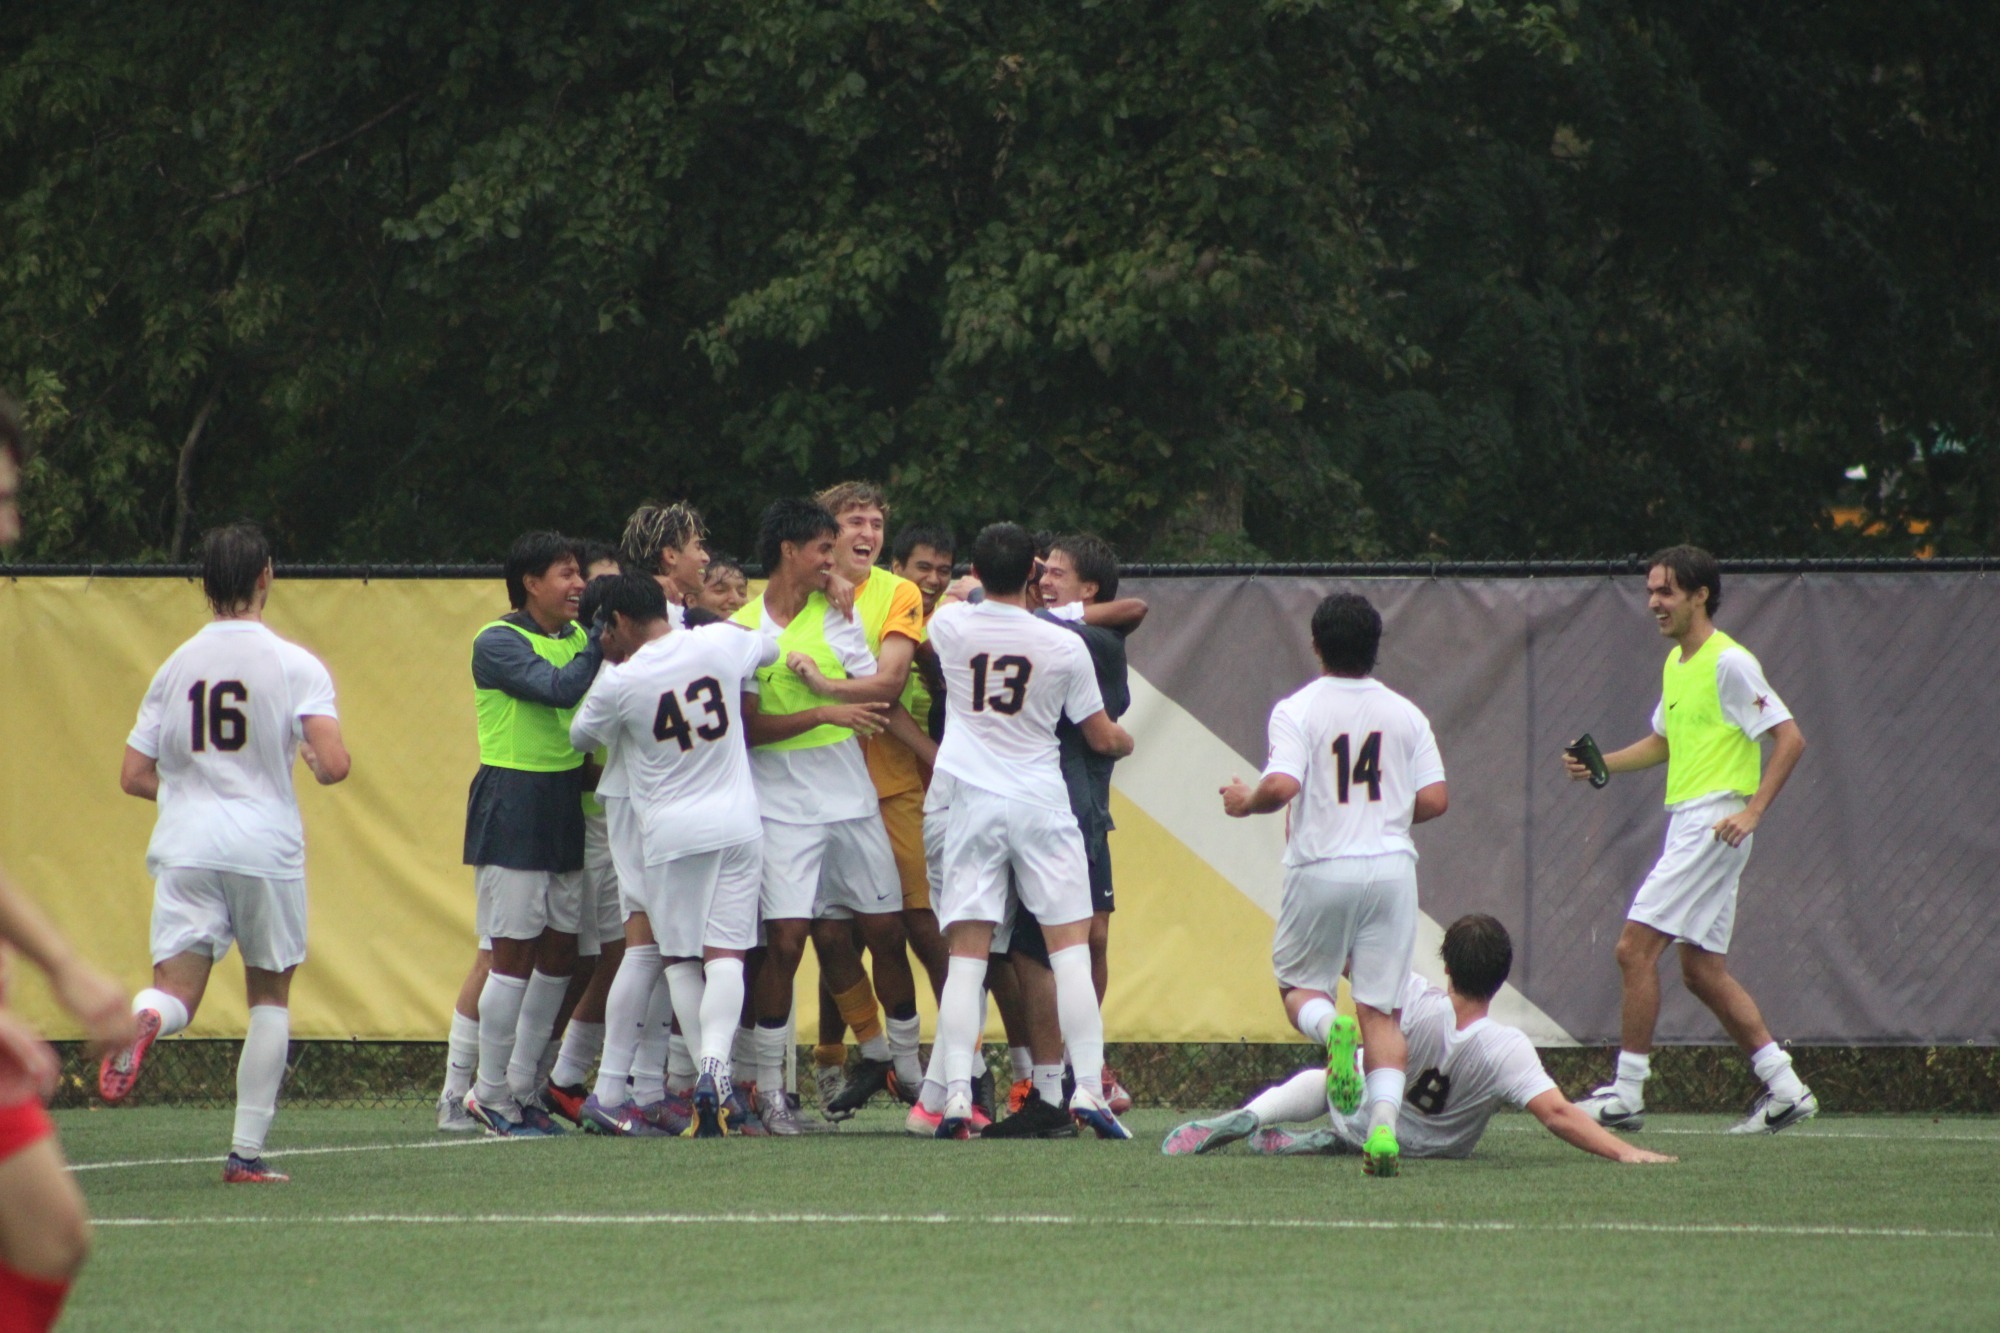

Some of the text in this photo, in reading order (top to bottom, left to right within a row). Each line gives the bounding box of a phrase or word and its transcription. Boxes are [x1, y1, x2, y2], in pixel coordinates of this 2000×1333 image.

[188, 680, 248, 752] 16
[653, 675, 730, 753] 43
[969, 652, 1033, 716] 13
[1331, 730, 1383, 804] 14
[1406, 1067, 1451, 1115] 8
